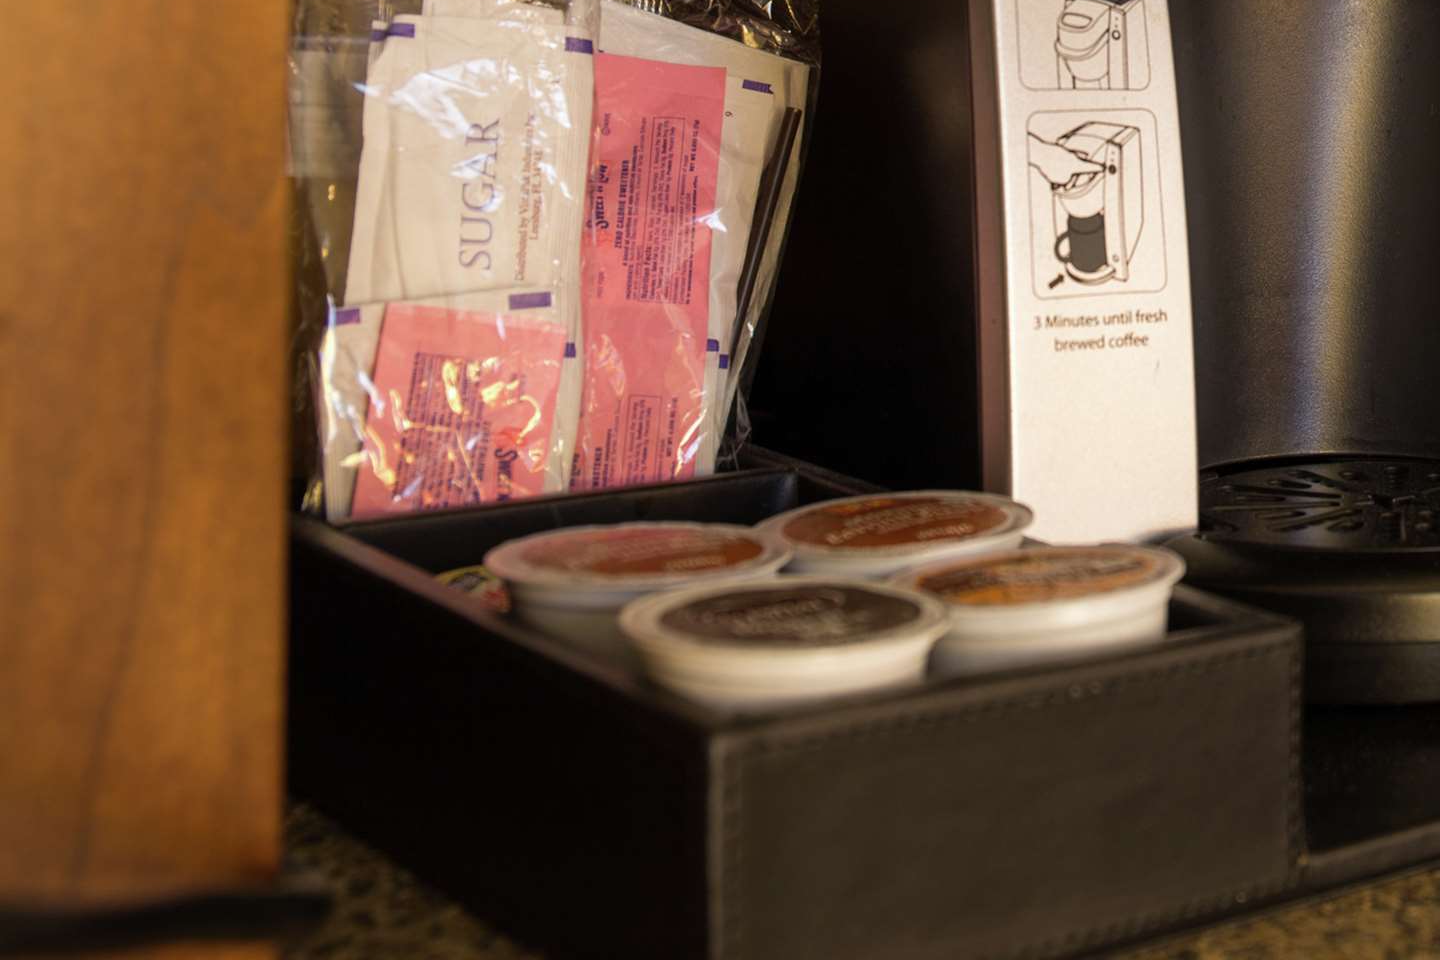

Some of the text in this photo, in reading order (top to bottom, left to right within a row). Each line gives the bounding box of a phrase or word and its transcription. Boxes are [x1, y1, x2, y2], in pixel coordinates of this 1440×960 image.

[459, 118, 500, 271] SUGAR
[615, 159, 630, 248] ZERO CALORIE SWEETENER
[641, 267, 650, 299] Nutrition
[1034, 308, 1167, 329] 3 Minutes until fresh
[1054, 332, 1149, 352] brewed coffee
